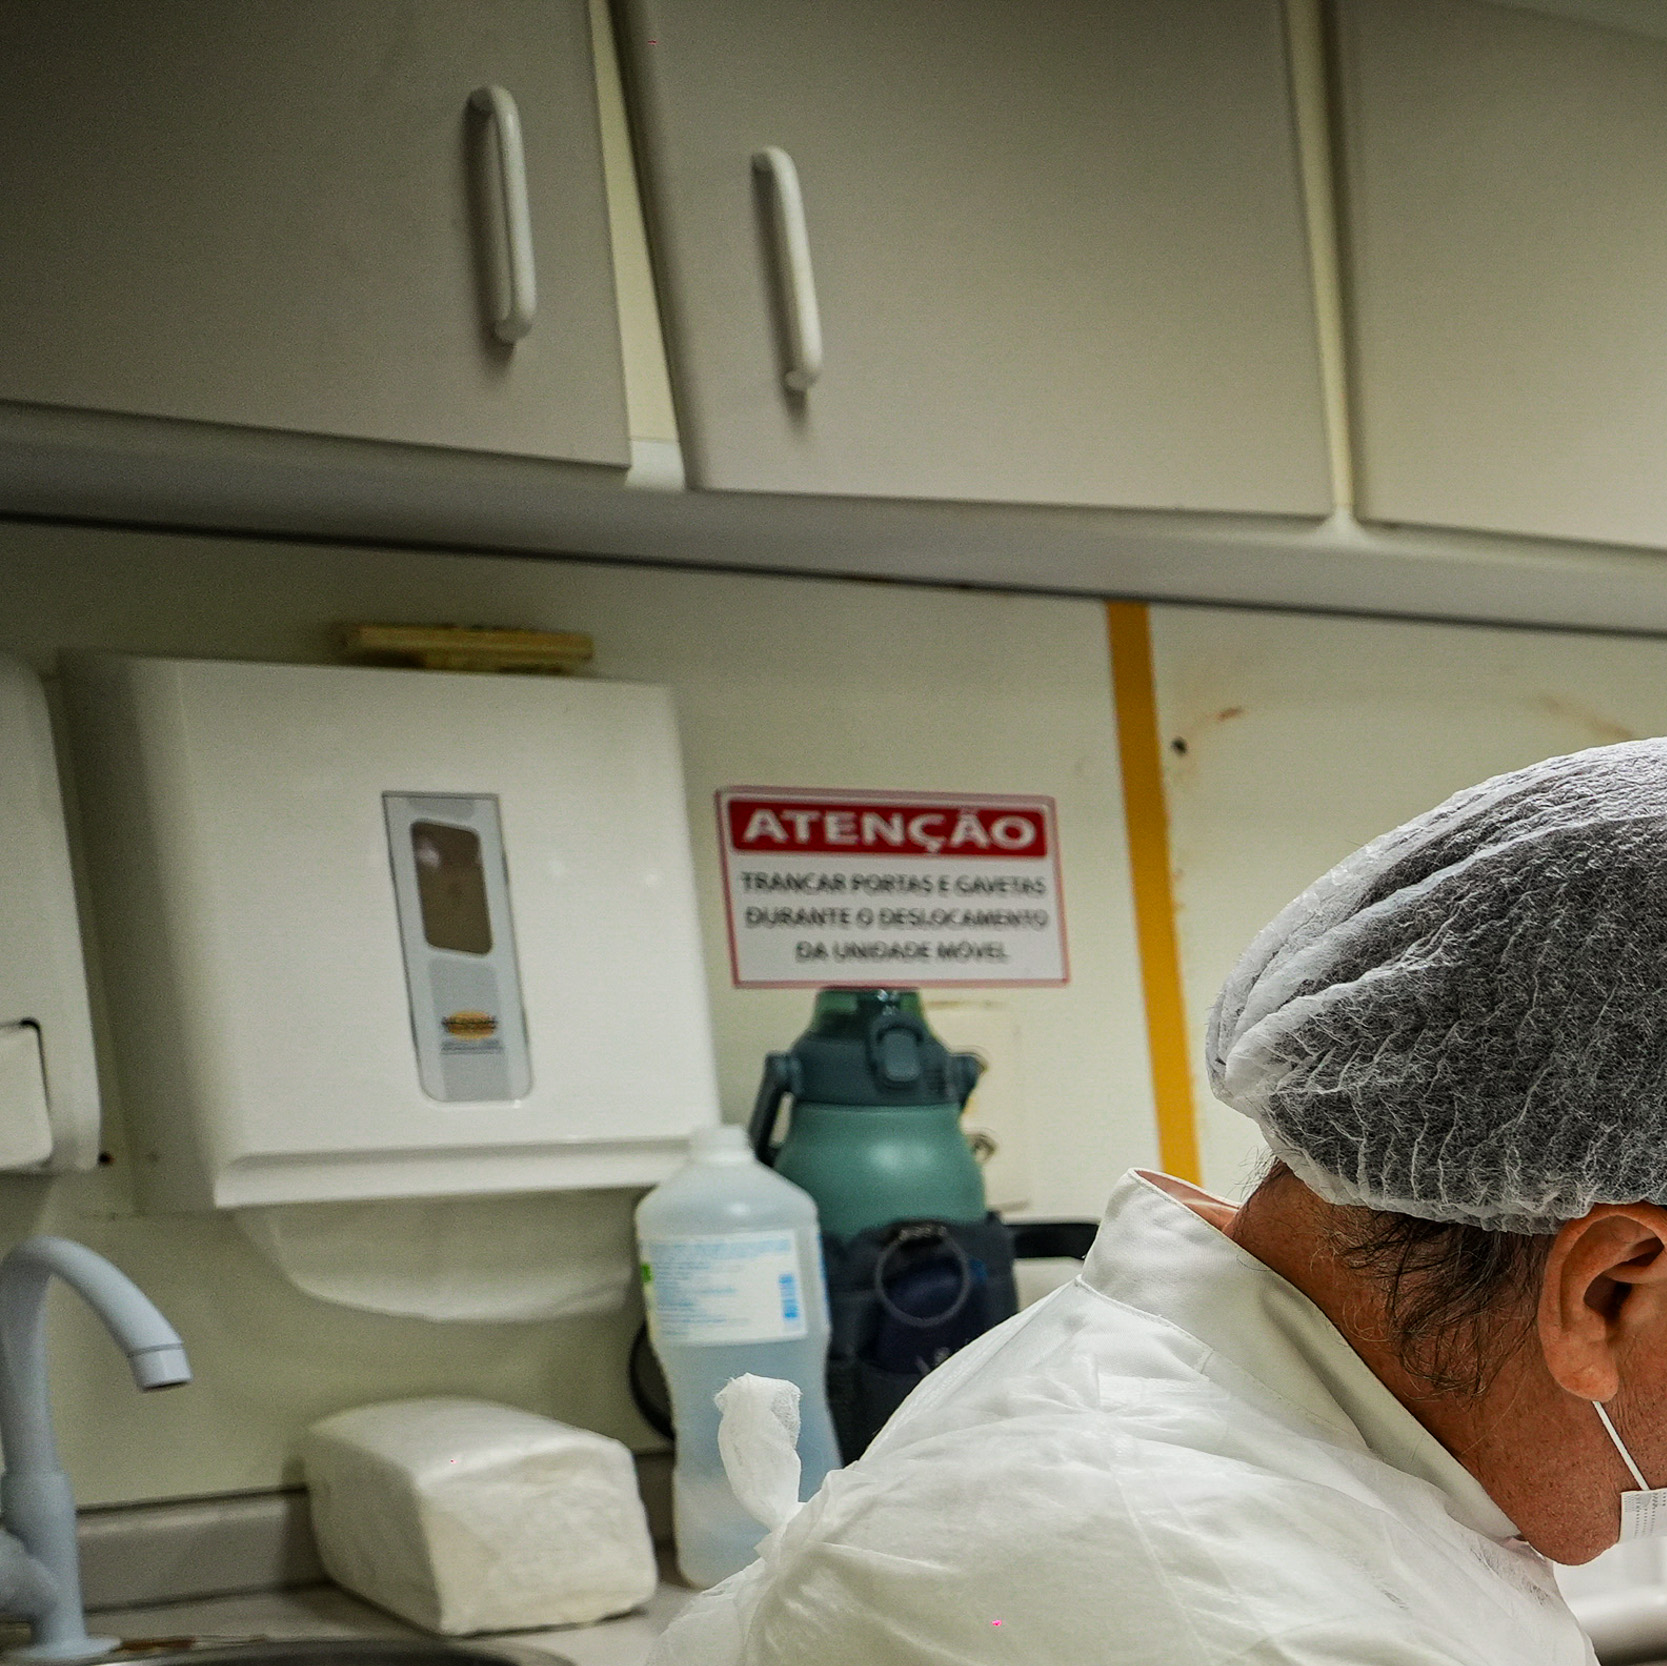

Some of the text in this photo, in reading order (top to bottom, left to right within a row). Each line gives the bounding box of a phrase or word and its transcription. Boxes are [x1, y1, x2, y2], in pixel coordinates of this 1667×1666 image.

[742, 806, 1037, 853] ATENÇÃO
[741, 871, 1047, 898] TRANCAR PORTAS E GAVETAS
[744, 906, 1050, 931] DURANTE O DESLOCAMENTO
[795, 936, 1010, 963] DA UNIDADE MÓVEL
